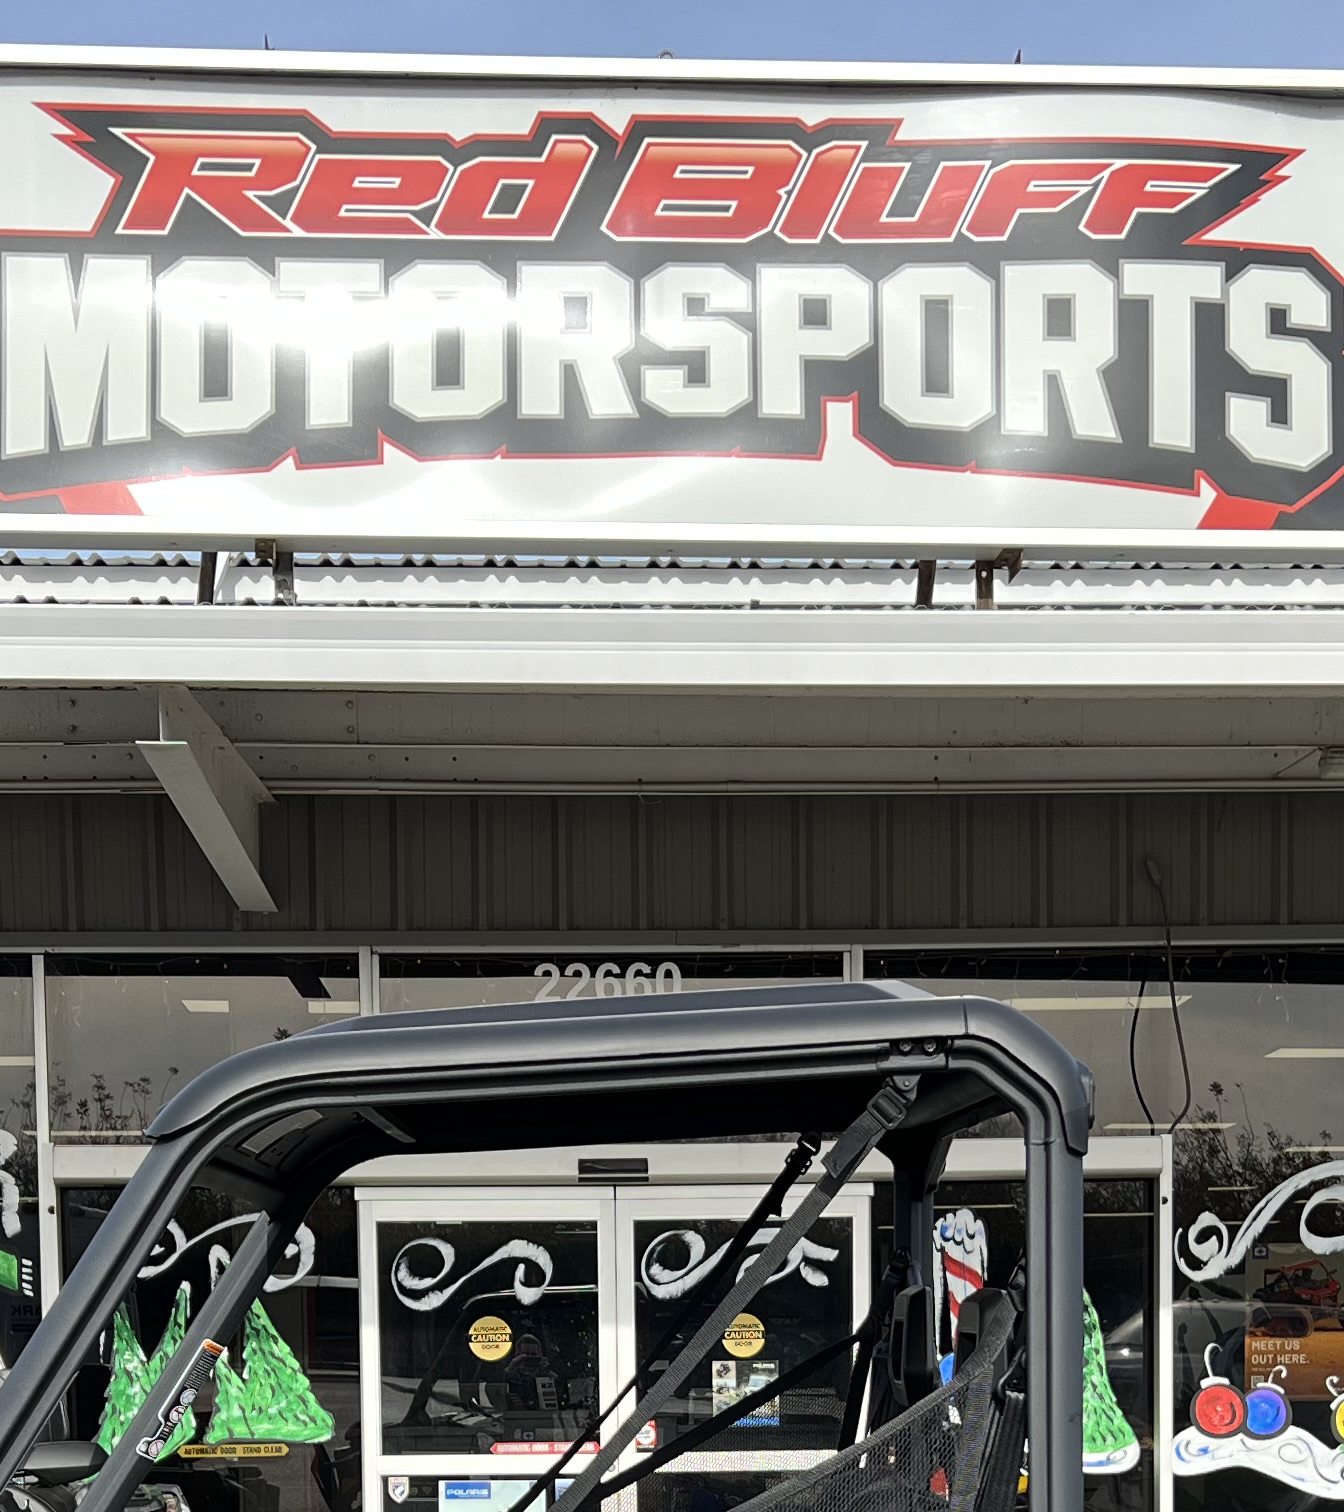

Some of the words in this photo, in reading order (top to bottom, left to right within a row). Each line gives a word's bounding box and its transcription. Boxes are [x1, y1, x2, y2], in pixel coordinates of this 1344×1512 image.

[109, 127, 601, 241] Red
[1, 251, 1335, 473] MOTORSPORTS
[533, 961, 682, 1001] 22660
[471, 1334, 510, 1342] CAUTION
[724, 1330, 763, 1339] CAUTION
[1251, 1340, 1282, 1350] MEET
[1284, 1340, 1300, 1350] US
[1251, 1354, 1274, 1364] OUT
[1276, 1354, 1310, 1364] HERE.
[446, 1488, 489, 1496] POLARIS
